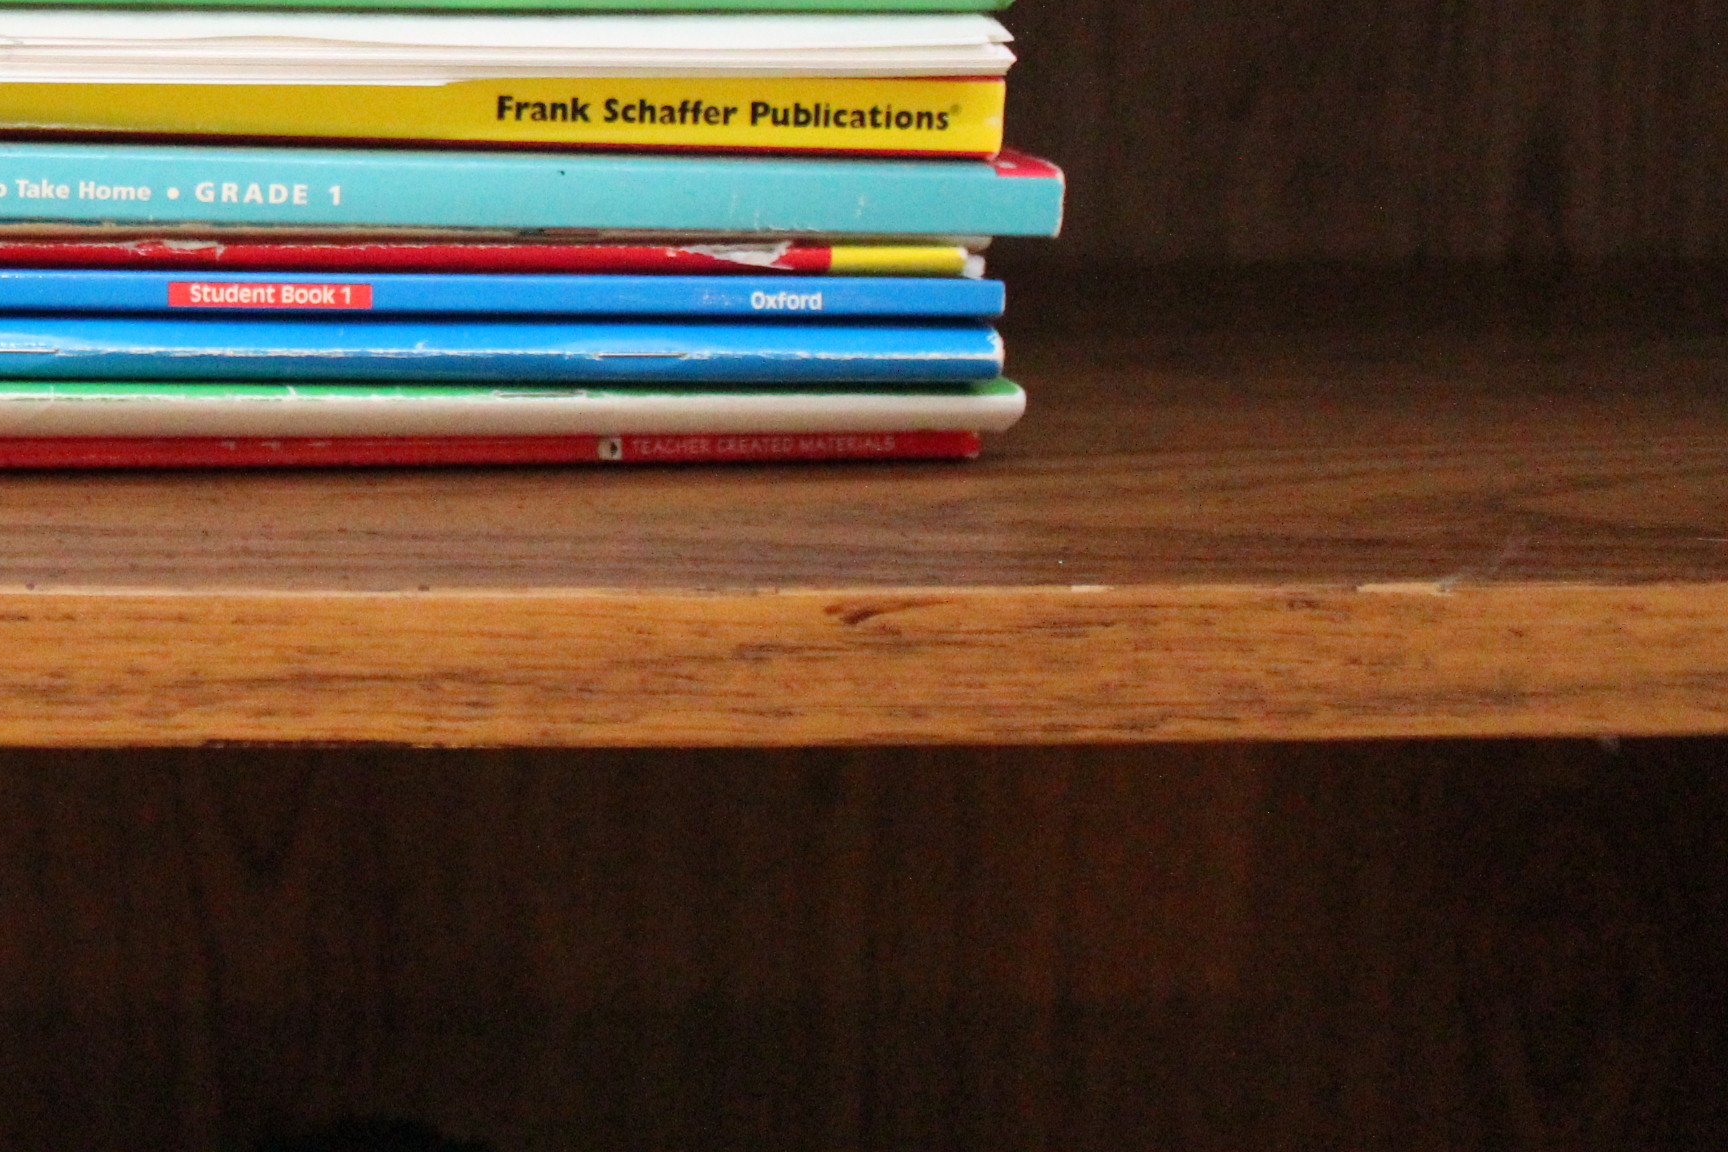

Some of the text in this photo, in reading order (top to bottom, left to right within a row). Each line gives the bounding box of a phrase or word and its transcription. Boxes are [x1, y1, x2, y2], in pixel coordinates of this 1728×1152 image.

[497, 94, 590, 124] Frank
[603, 97, 738, 127] Schaffer
[15, 180, 70, 200] Take
[78, 181, 152, 201] Home
[195, 181, 309, 205] GRADE
[328, 185, 342, 207] 1
[189, 282, 352, 305] Student Book 1
[751, 290, 823, 311] Oxford
[632, 435, 896, 454] TEACHER CREATED MATERIALS
